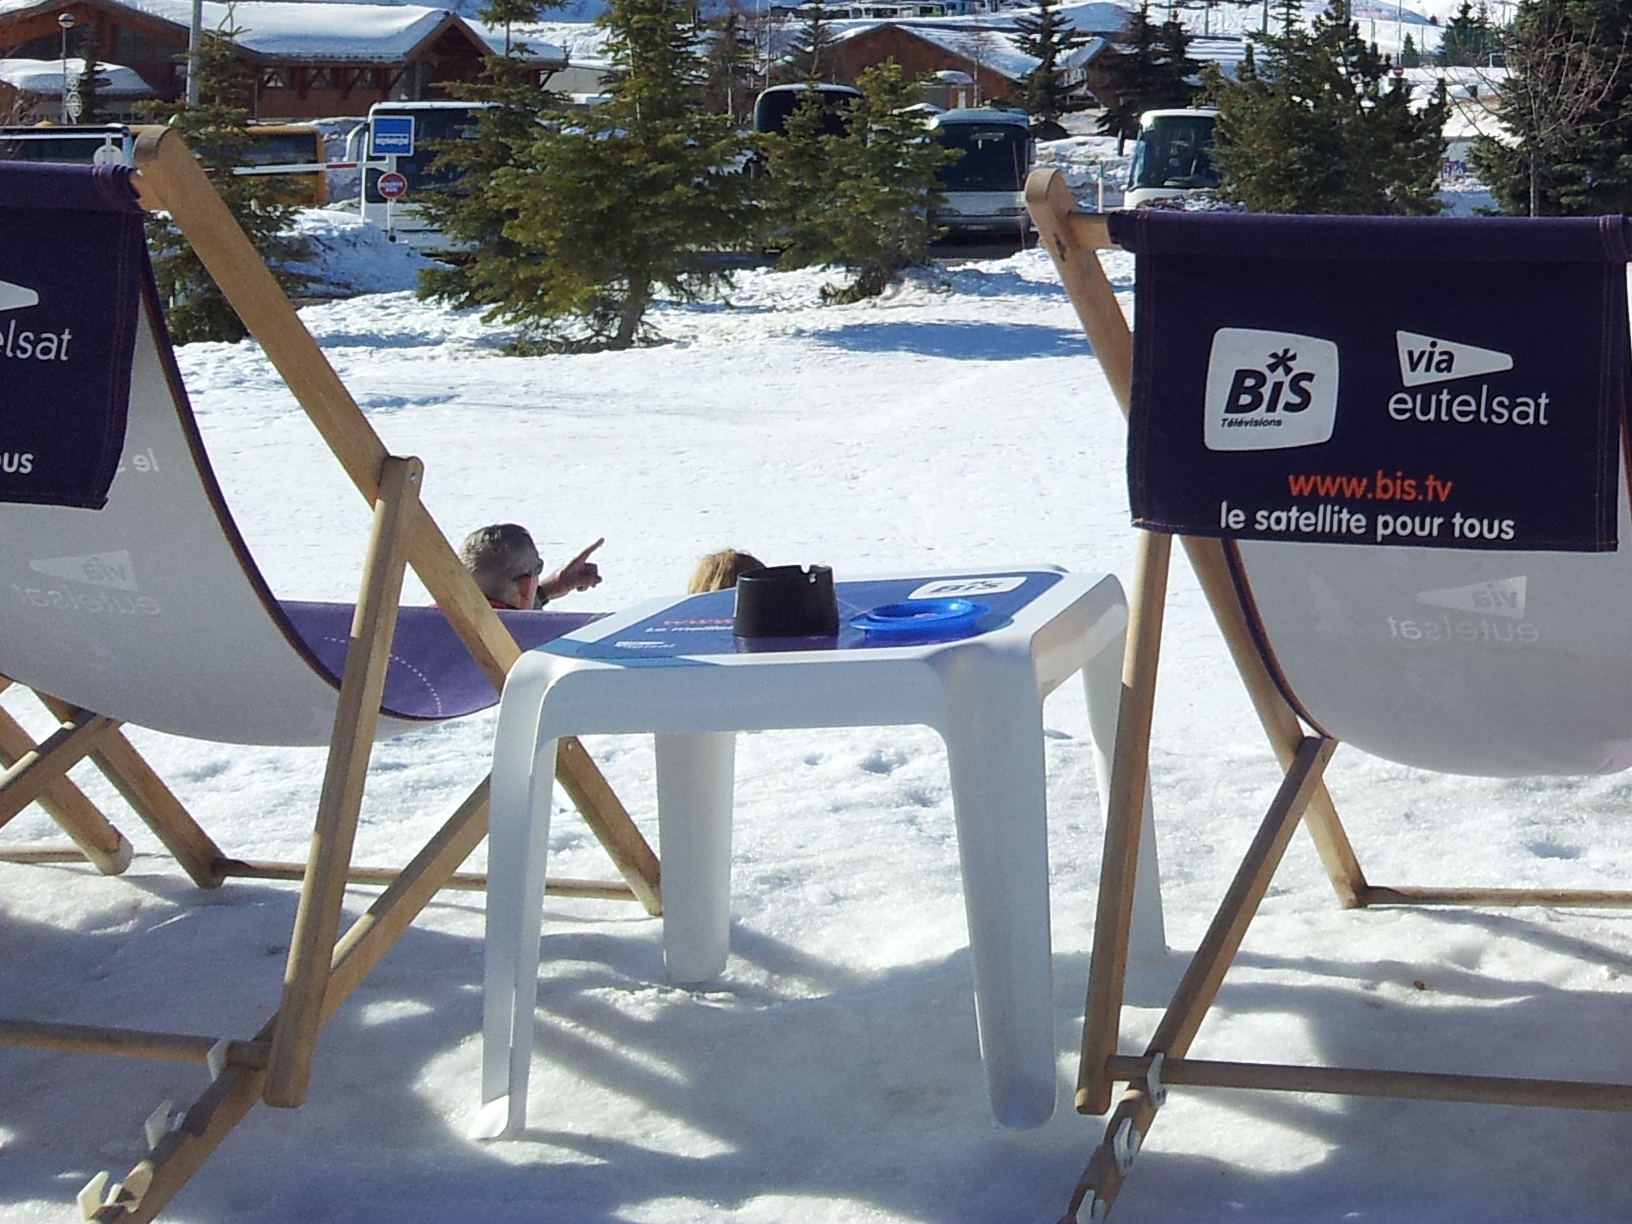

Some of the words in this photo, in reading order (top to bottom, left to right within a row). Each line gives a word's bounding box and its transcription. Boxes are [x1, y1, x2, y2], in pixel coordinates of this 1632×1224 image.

[1406, 340, 1456, 375] via
[1220, 416, 1283, 428] Télévisions
[1387, 384, 1550, 426] eutelsat
[1287, 469, 1454, 502] www.bis.tv
[1220, 501, 1246, 530] le
[1254, 504, 1368, 536] satellite
[1376, 515, 1445, 542] pour
[1451, 511, 1516, 540] tous
